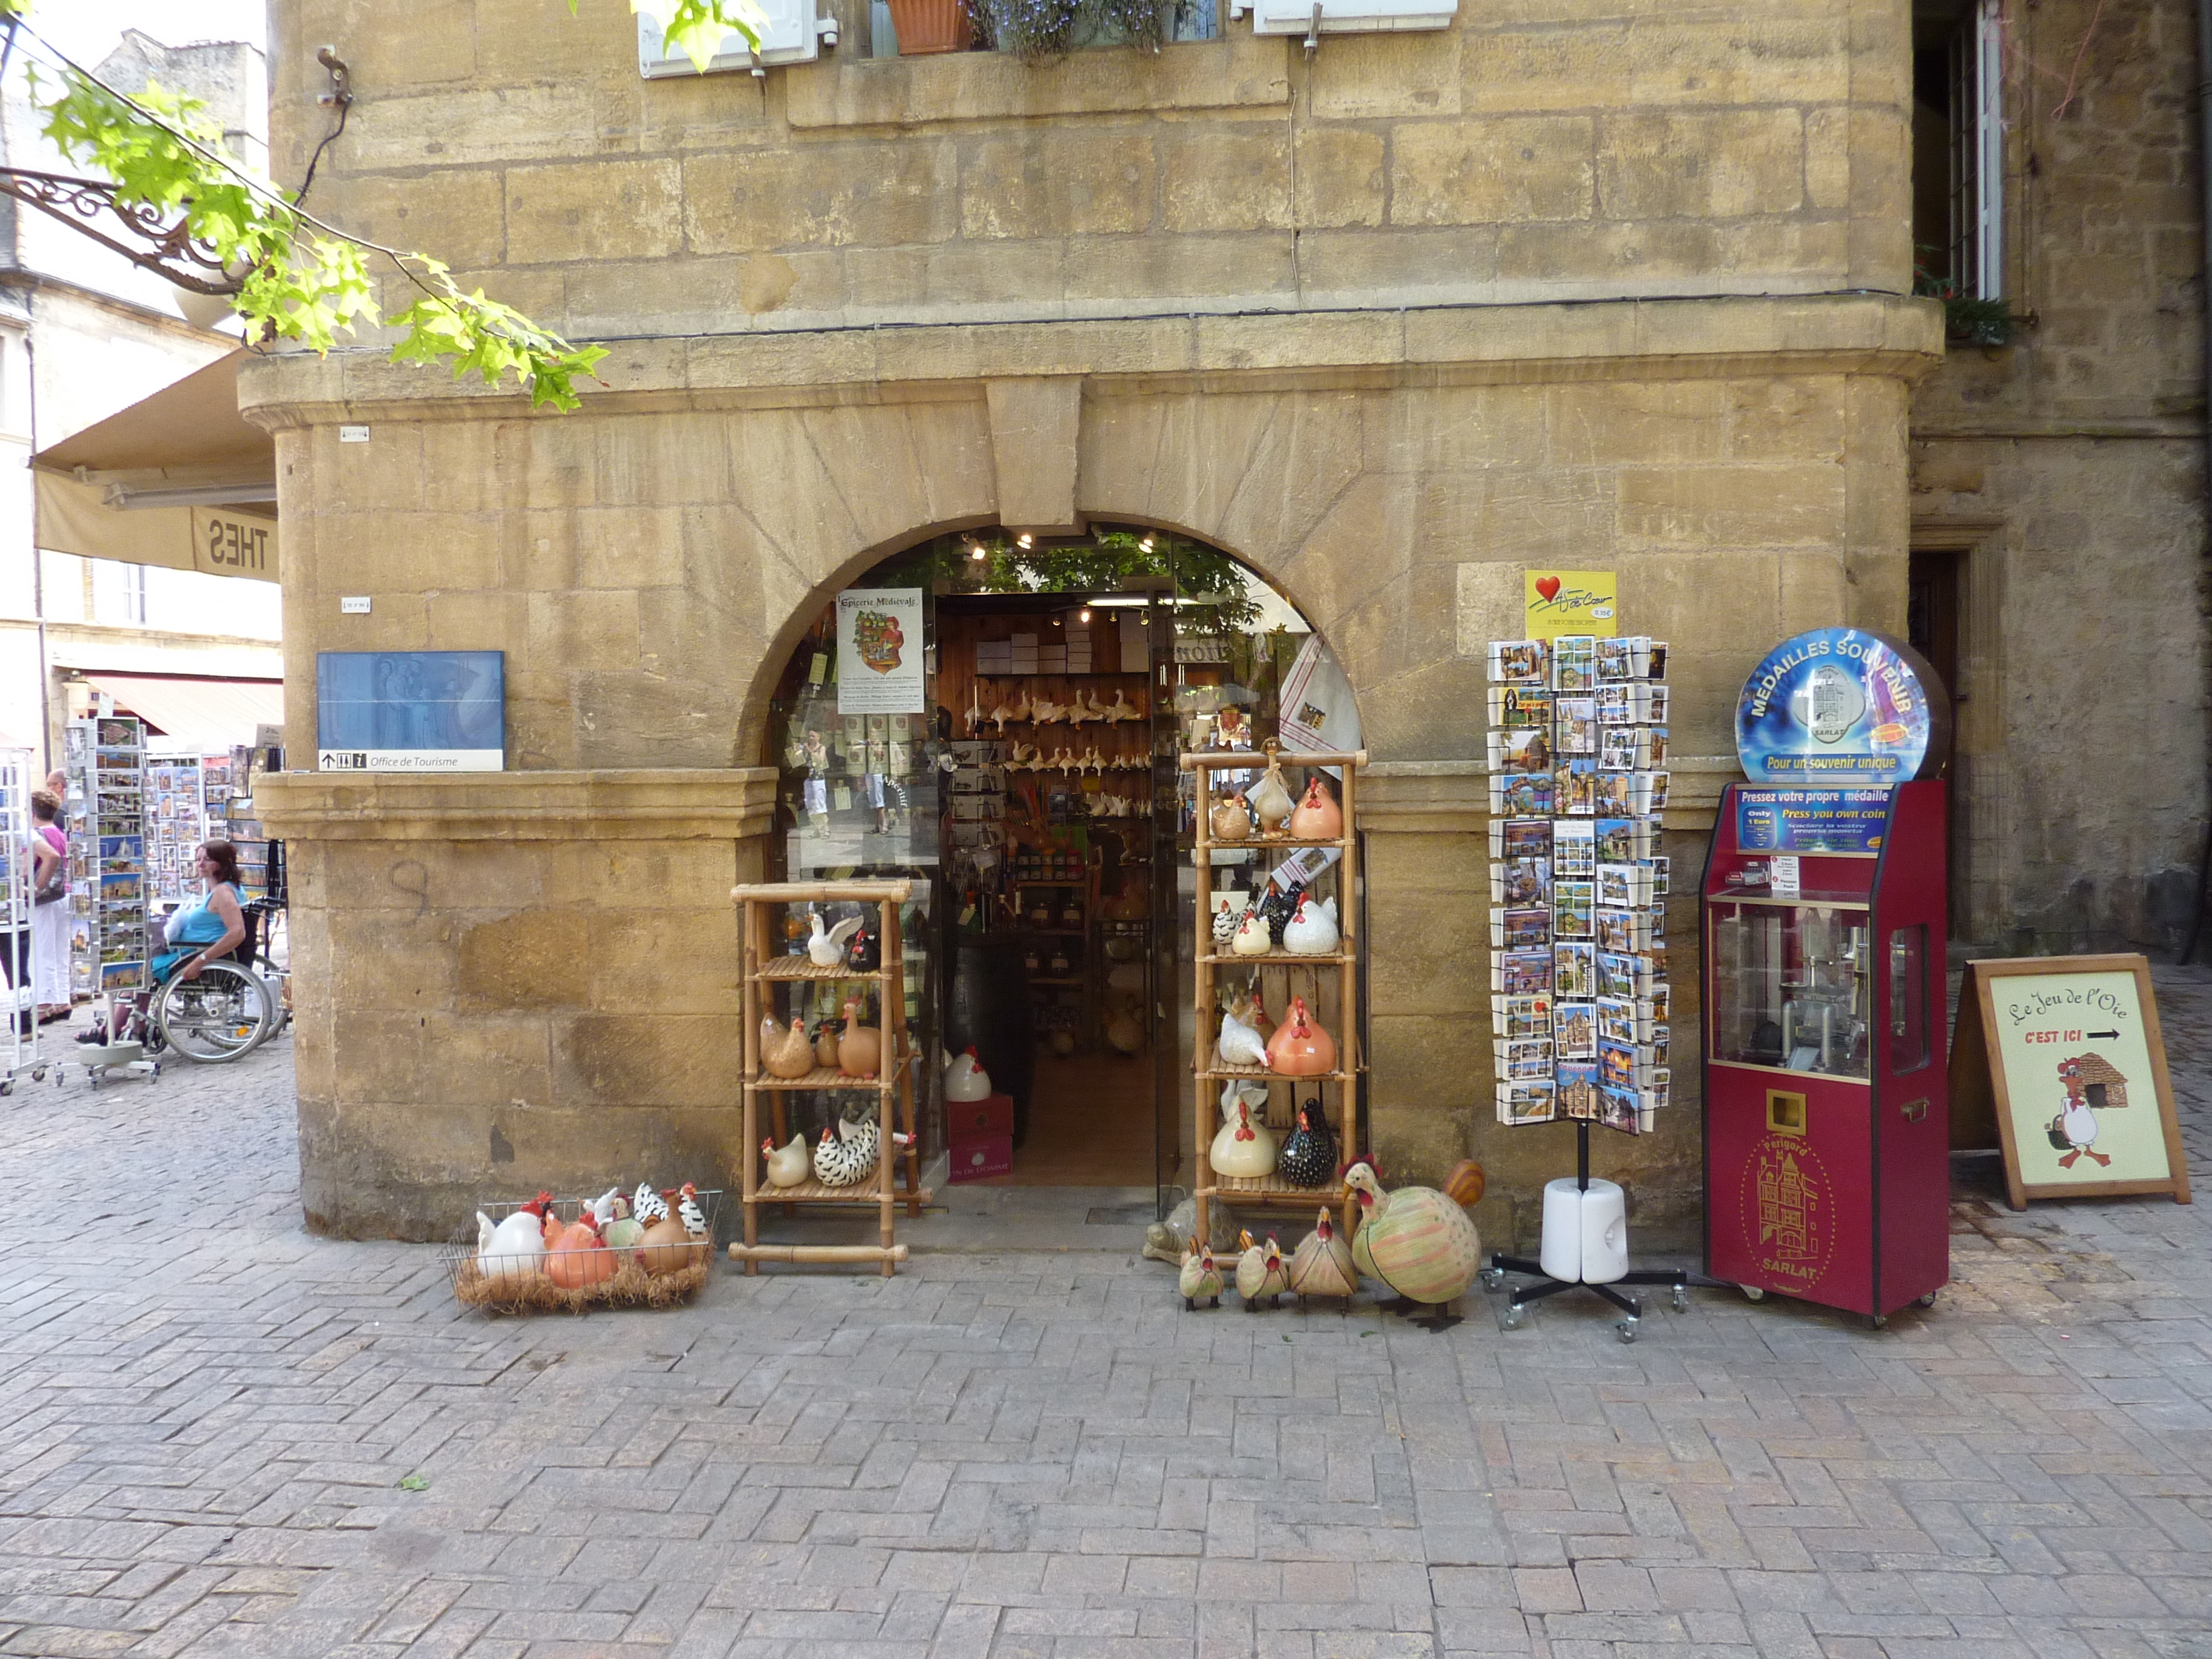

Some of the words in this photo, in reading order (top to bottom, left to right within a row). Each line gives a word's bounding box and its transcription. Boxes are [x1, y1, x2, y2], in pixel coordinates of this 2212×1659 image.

[1835, 640, 1913, 715] SOUVENIR
[370, 757, 398, 766] Office
[400, 757, 412, 766] de
[414, 757, 458, 766] Tourisme
[1767, 756, 1791, 769] Pour
[1793, 759, 1807, 768] un
[1810, 755, 1856, 768] souvenir
[1857, 755, 1896, 771] unique
[1741, 792, 1776, 803] Pressez
[1778, 792, 1804, 802] votre
[1806, 792, 1839, 804] propre
[1845, 790, 1889, 802] médaille
[1782, 809, 1810, 819] Press
[1813, 810, 1834, 820] you
[1836, 810, 1858, 819] own
[1862, 809, 1886, 819] coin
[2009, 1004, 2031, 1025] Le
[2031, 990, 2062, 1015] Jeu
[2065, 988, 2082, 1004] de
[2087, 988, 2127, 1019] l'Oie
[2025, 1031, 2059, 1044] C'EST
[2063, 1030, 2082, 1042] ICI
[1762, 1258, 1817, 1280] SARLAT
